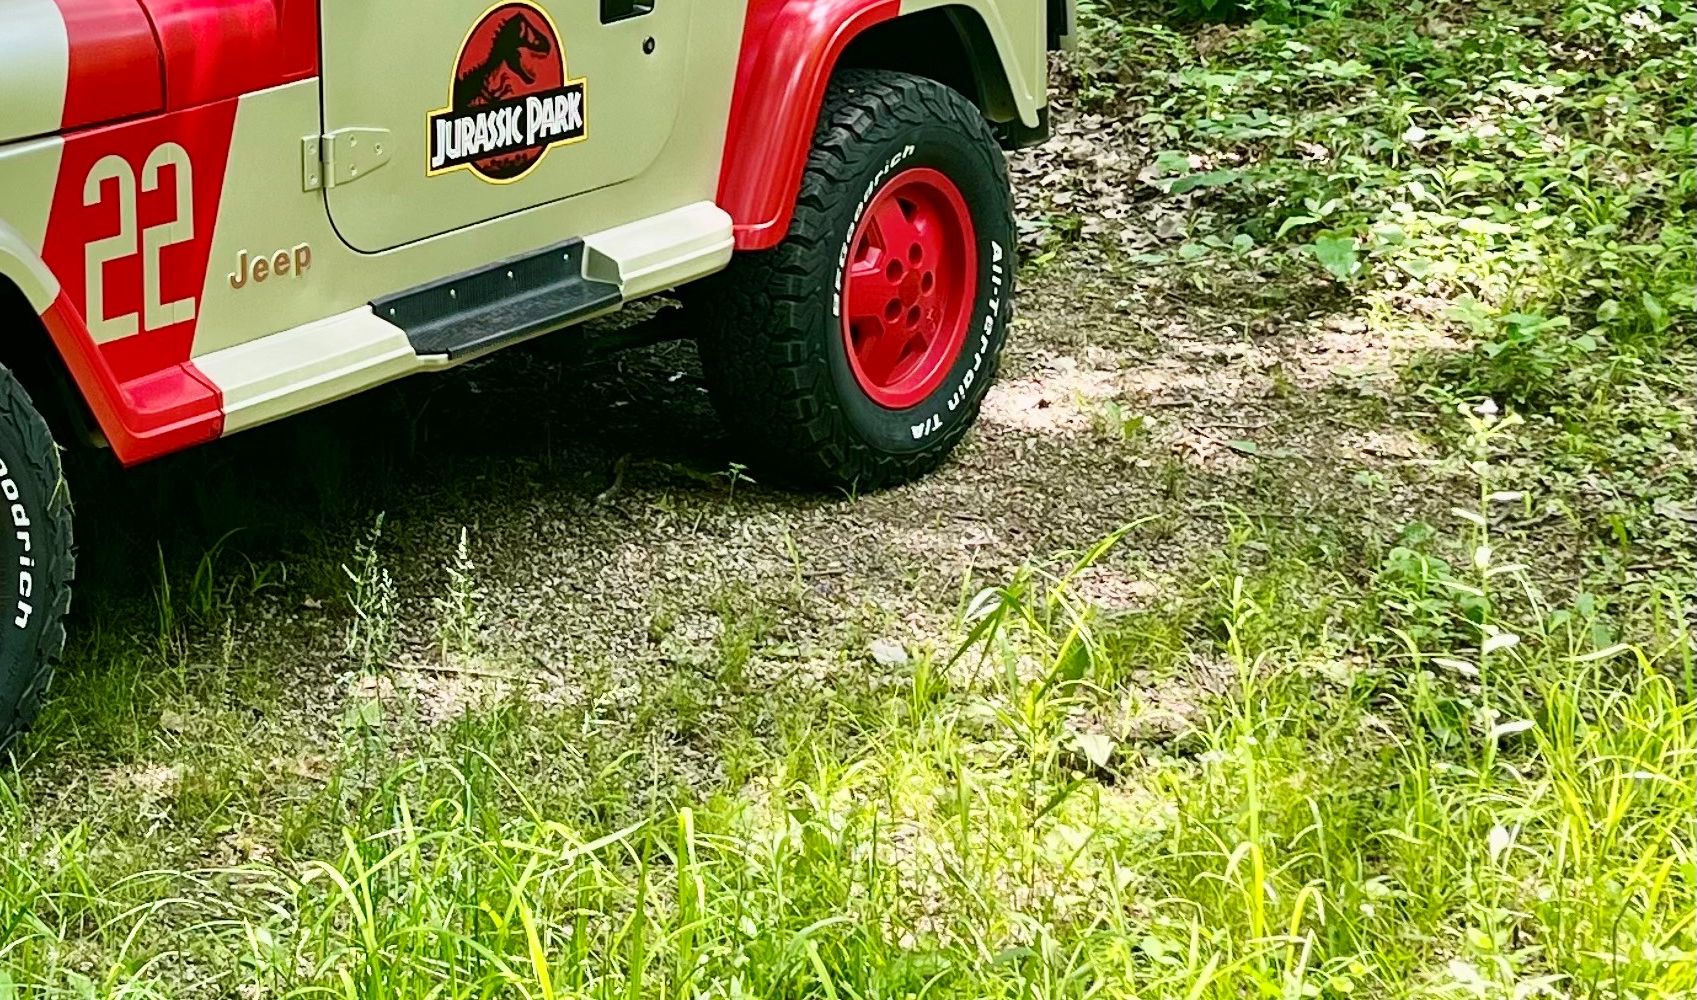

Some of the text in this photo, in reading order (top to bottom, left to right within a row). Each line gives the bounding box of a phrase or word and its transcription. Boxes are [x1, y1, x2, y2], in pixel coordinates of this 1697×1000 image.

[432, 91, 583, 168] JURASSIC PARK
[83, 141, 195, 345] 22
[229, 241, 312, 290] Jeep
[910, 240, 1003, 439] All-Terrain T/A
